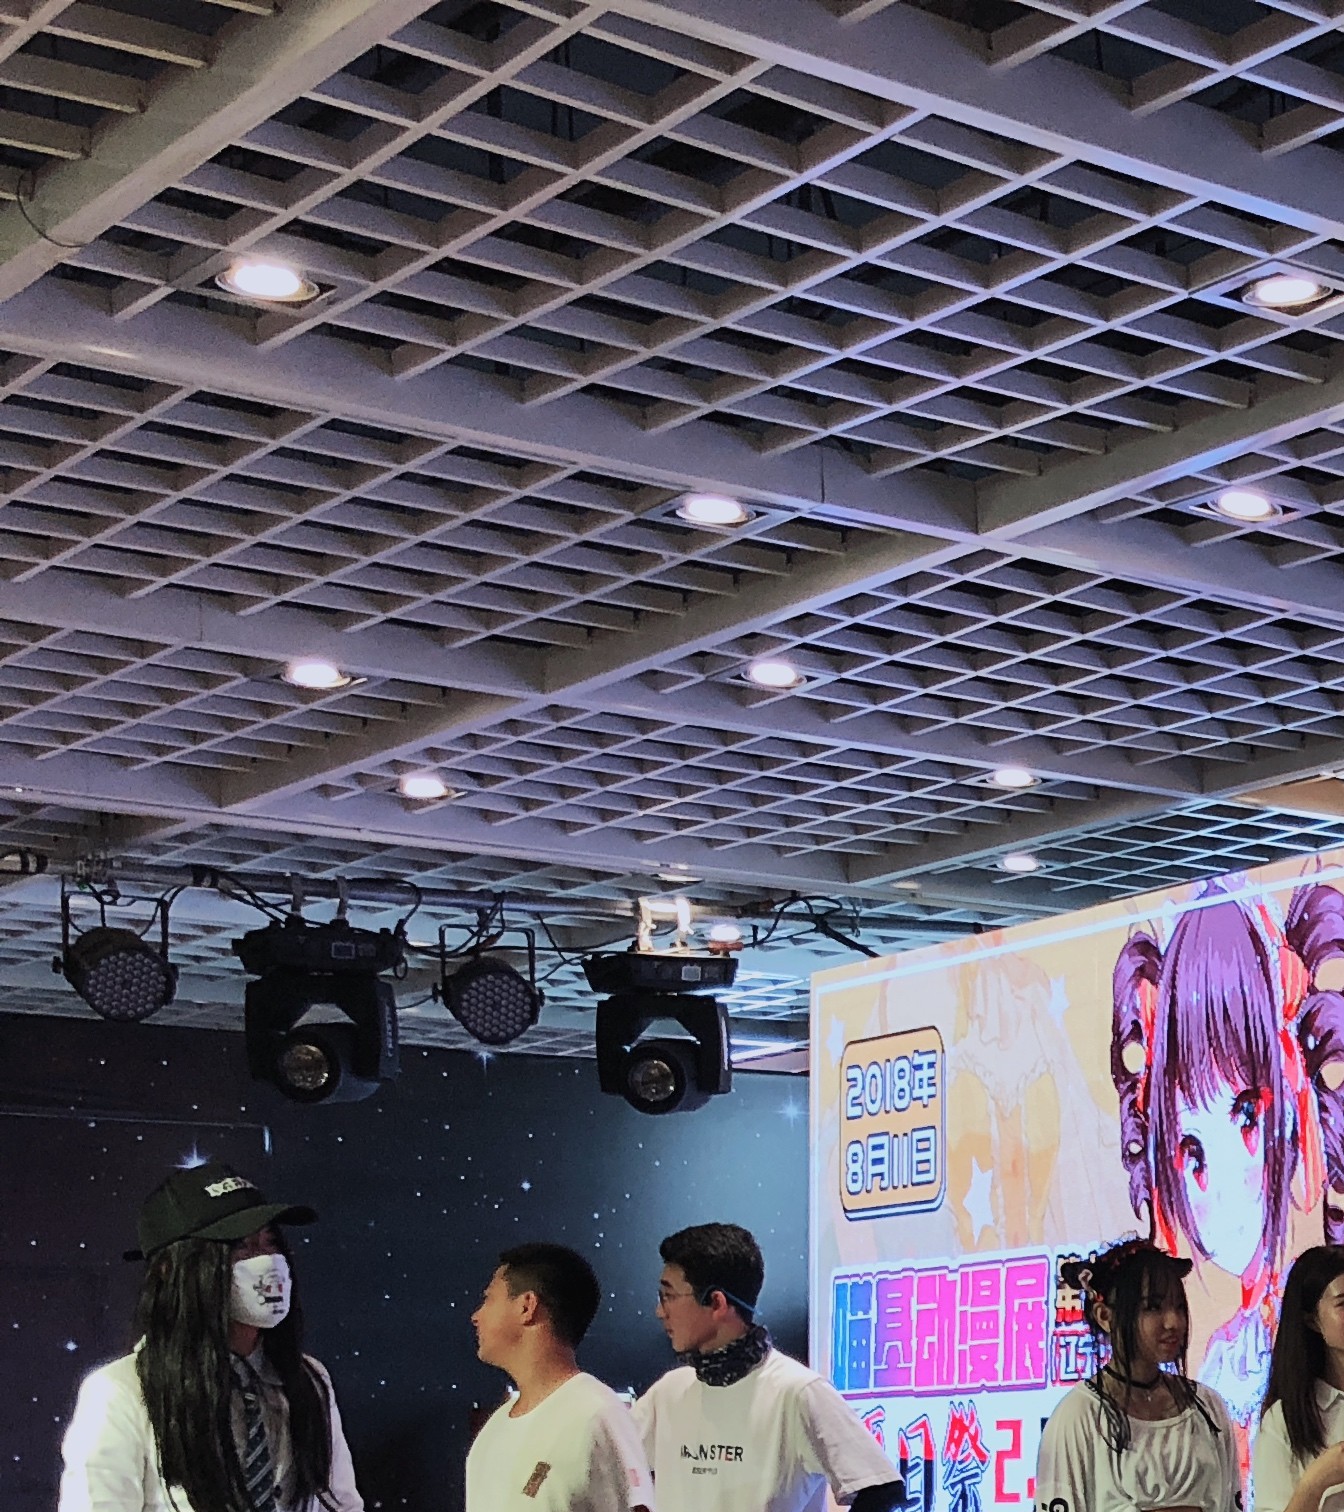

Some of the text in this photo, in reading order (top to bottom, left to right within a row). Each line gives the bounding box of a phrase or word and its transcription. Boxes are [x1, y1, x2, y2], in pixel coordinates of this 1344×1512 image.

[844, 1050, 937, 1121] 2018年
[844, 1125, 937, 1195] 8月11日
[835, 1258, 1048, 1390] 喵基动漫展
